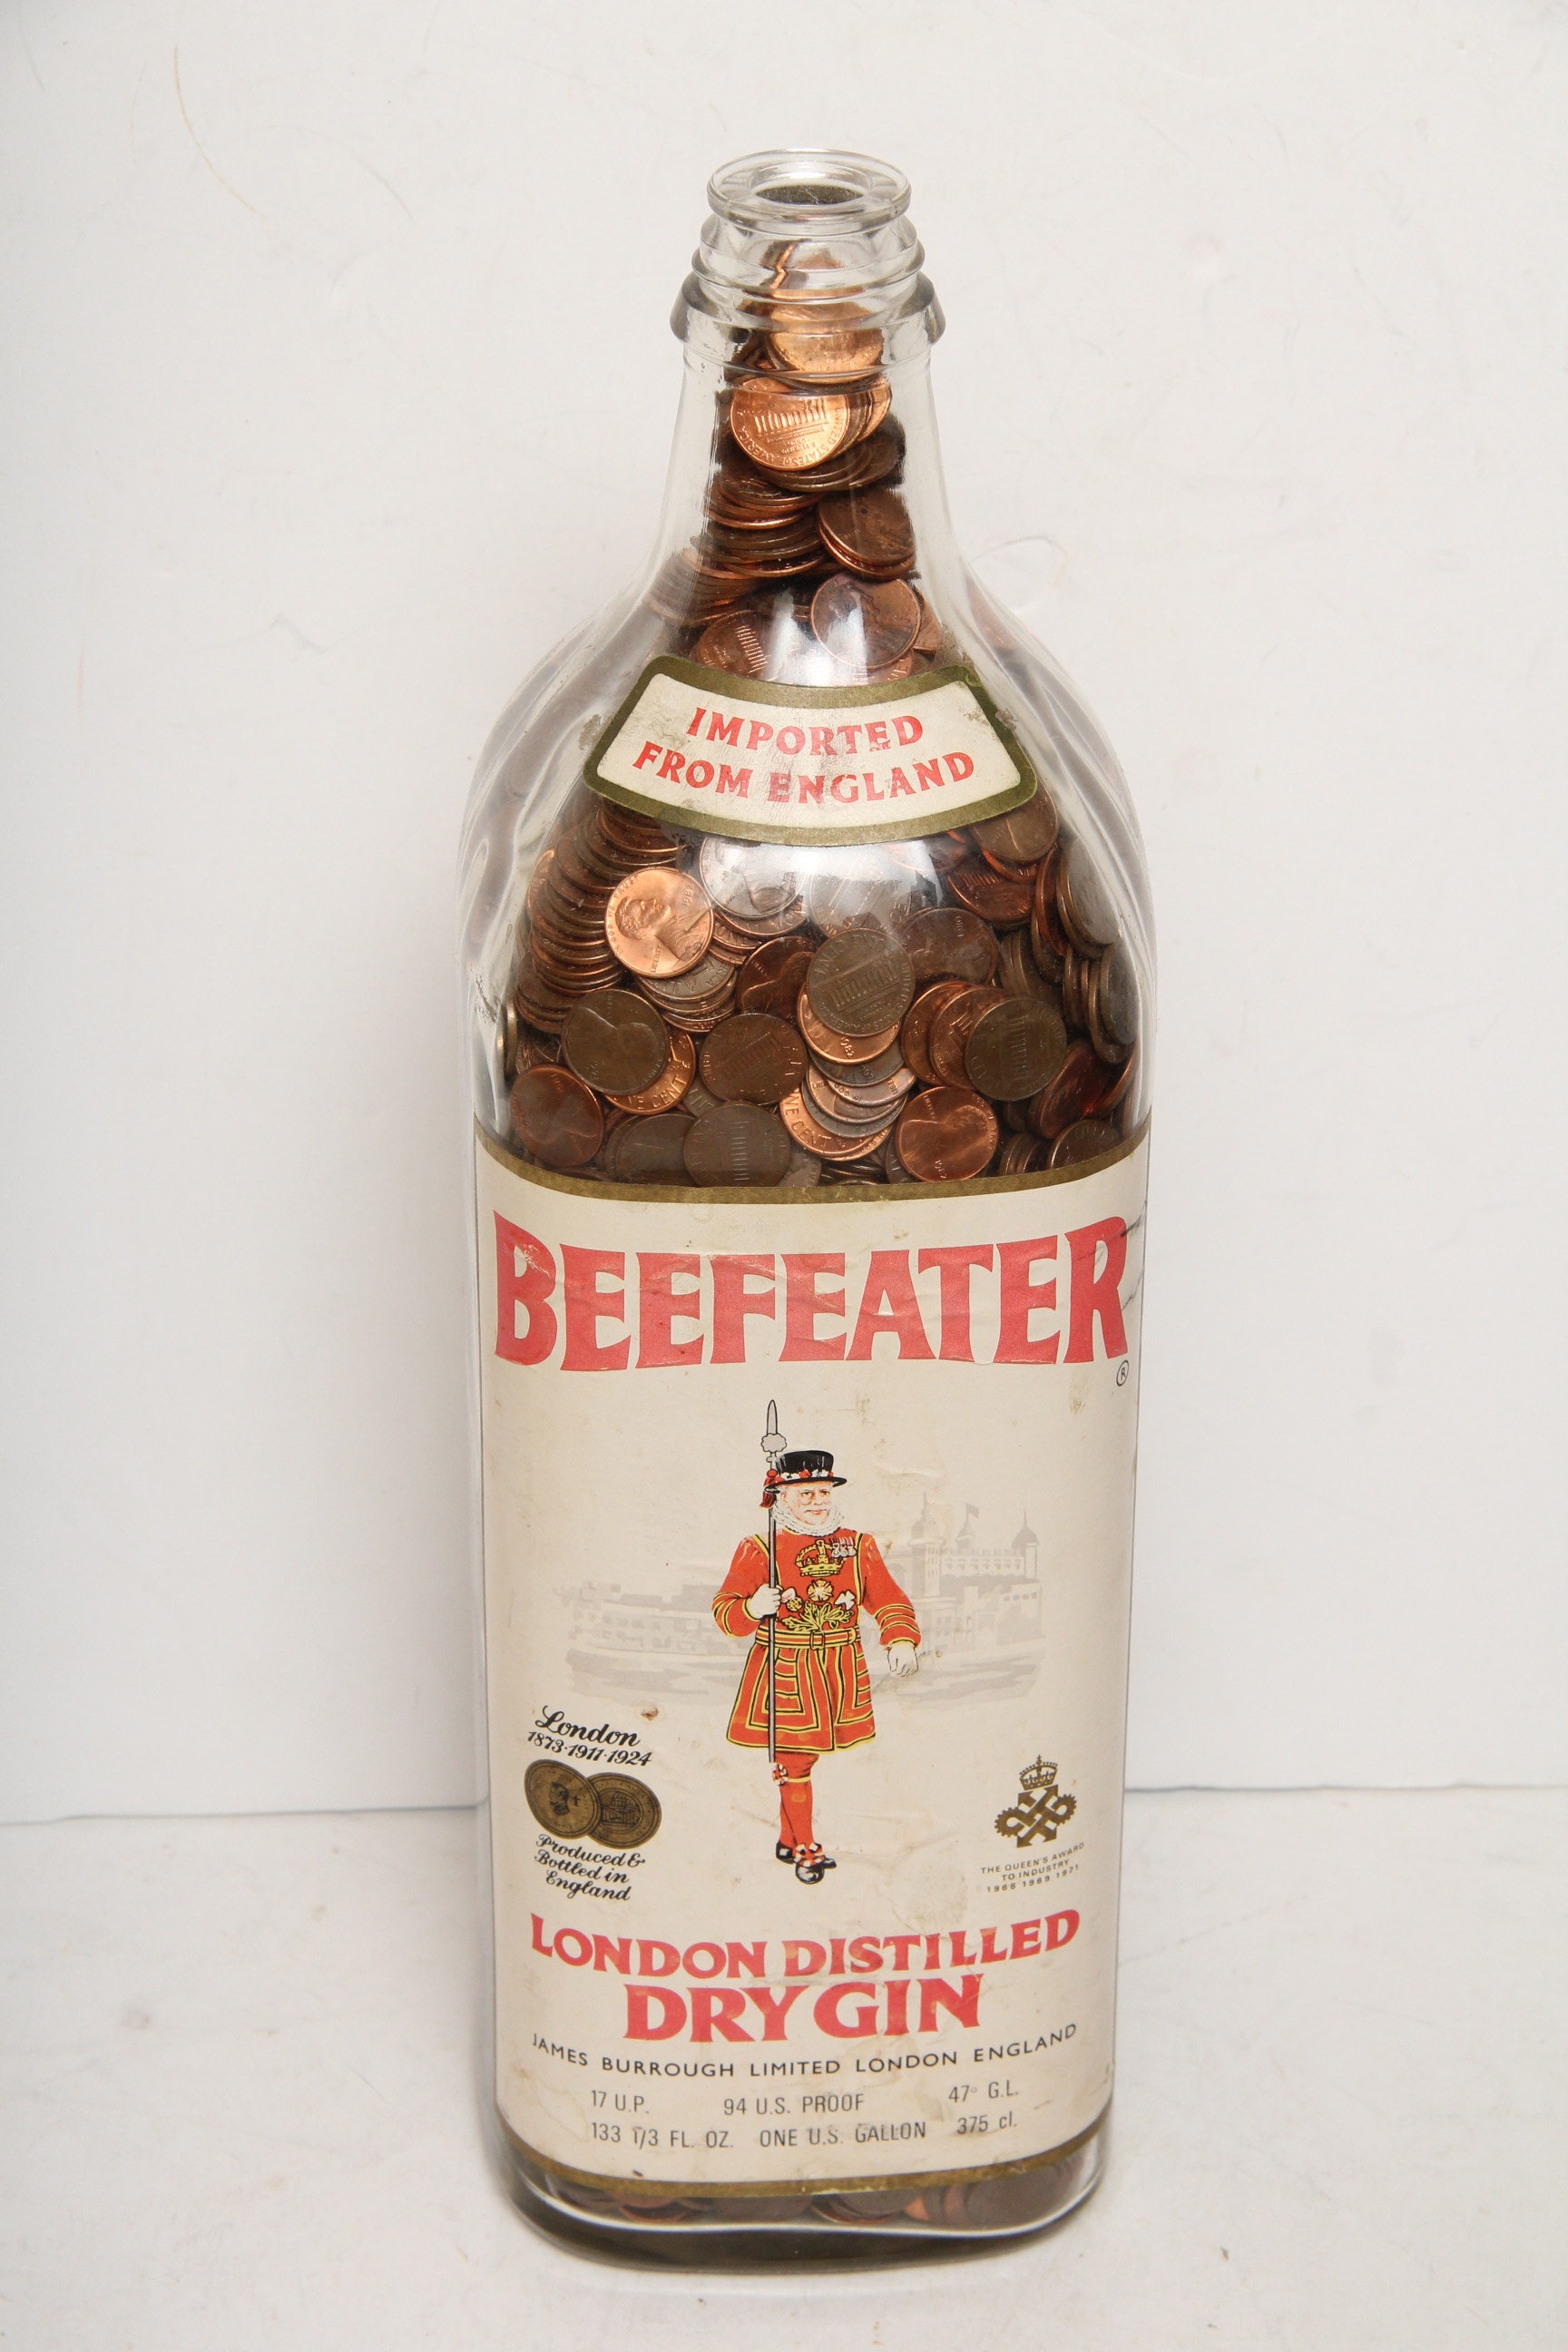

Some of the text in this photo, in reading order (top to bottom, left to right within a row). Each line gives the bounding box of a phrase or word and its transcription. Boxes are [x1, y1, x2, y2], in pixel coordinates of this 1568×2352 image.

[686, 707, 925, 756] IMPORTED
[632, 740, 975, 804] FROM ENGLAND
[493, 1210, 1129, 1372] BEEFEATER
[534, 1705, 642, 1748] London
[534, 1848, 631, 1885] Bottled in
[535, 1833, 646, 1868] Produced &
[981, 1841, 1085, 1875] THE QUEEN'S AWARD
[1001, 1858, 1070, 1882] TO INDUSTRY
[545, 1869, 632, 1901] England
[530, 1908, 1081, 1979] LONDON DISTILLED
[622, 1973, 985, 2043] DRY GIN
[532, 2023, 1078, 2078] JAMES BURROUGH LIMITED LONDON ENGLAND
[590, 2090, 607, 2109] 17
[614, 2094, 650, 2115] U.P.
[722, 2097, 747, 2117] 94
[755, 2096, 792, 2116] U.S.
[802, 2093, 866, 2115] PROOF
[987, 2080, 1020, 2101] G.L.
[592, 2122, 622, 2144] 133
[632, 2126, 660, 2150] 1/3
[669, 2130, 695, 2151] FL.
[705, 2130, 734, 2150] OZ.
[760, 2128, 799, 2149] ONE
[808, 2125, 845, 2146] U.S.
[854, 2121, 927, 2144] GALLON
[956, 2113, 990, 2136] 375
